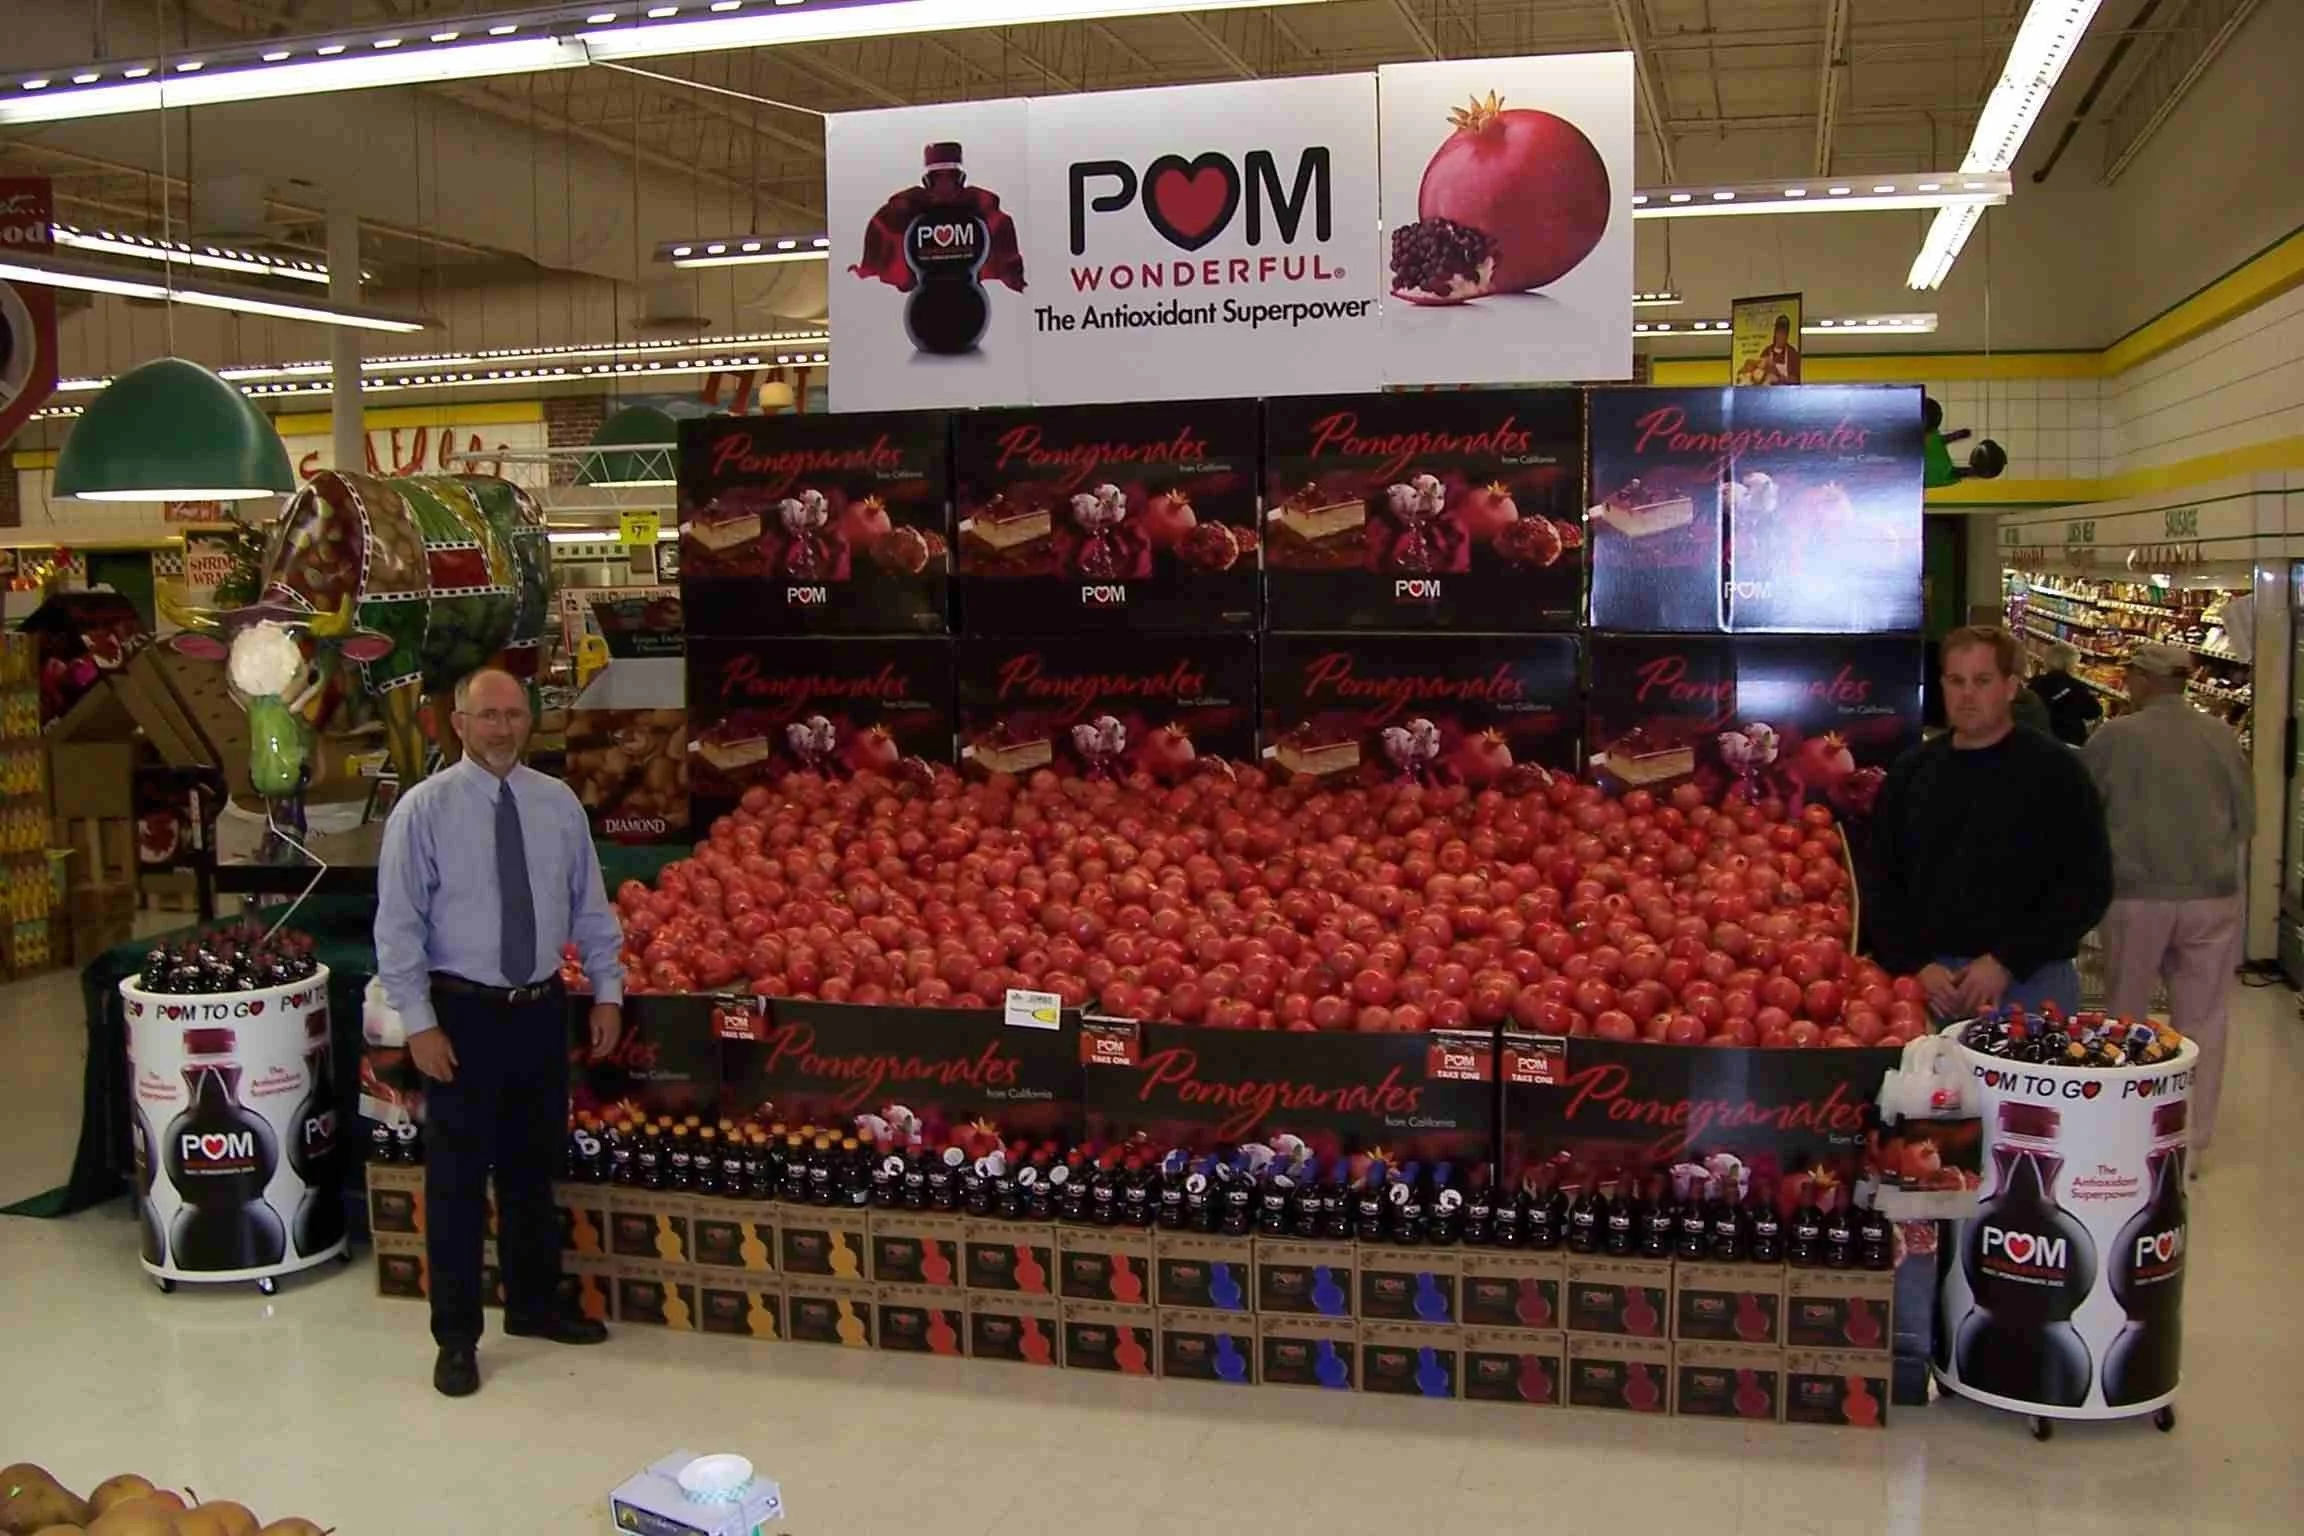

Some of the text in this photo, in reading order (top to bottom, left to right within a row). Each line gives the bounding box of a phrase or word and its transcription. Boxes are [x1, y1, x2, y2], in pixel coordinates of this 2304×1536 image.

[1069, 146, 1332, 256] POM
[1034, 299, 1371, 332] The Antioxidant Superpower
[997, 424, 1209, 493] Pomegranates
[1309, 411, 1534, 482] Pomegranates
[1635, 406, 1871, 478] Pomegranates
[1081, 584, 1126, 603] POM
[1395, 579, 1441, 598] POM
[605, 818, 666, 834] DIAMOND
[202, 1003, 229, 1021] TO
[763, 1022, 1022, 1111] Pomegranates
[2024, 1074, 2056, 1097] TO
[1138, 1048, 1425, 1140] Pomegranates
[1563, 1063, 1870, 1160] Pomegranates
[181, 1131, 255, 1161] POM
[1981, 1225, 2067, 1270] POM
